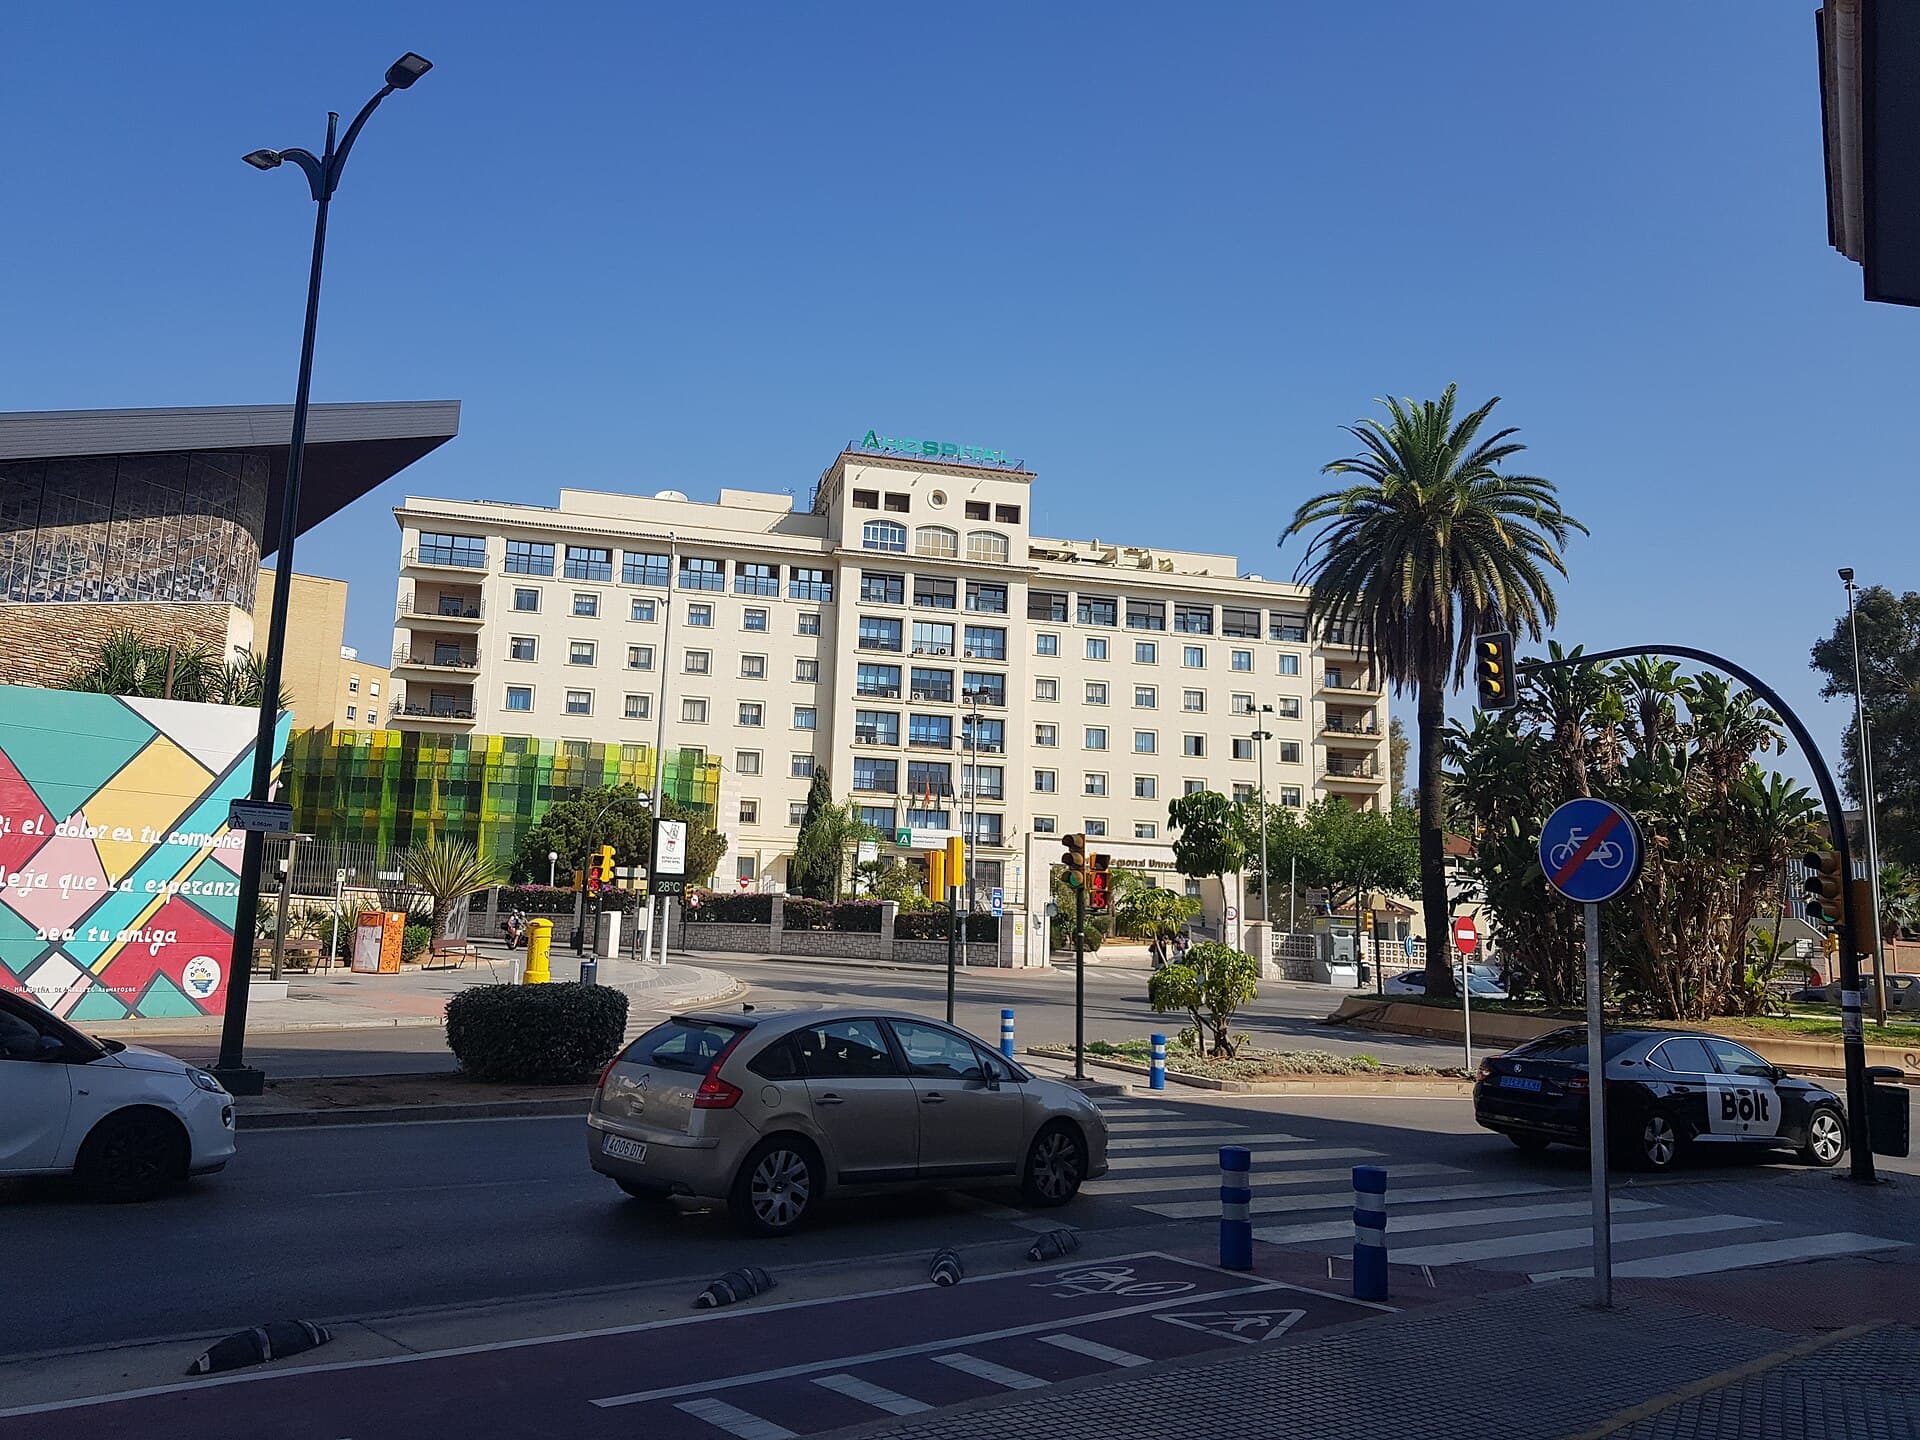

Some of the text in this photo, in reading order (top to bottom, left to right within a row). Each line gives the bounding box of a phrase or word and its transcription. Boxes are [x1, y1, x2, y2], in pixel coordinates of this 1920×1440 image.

[882, 436, 1015, 464] HOSPITAL
[22, 814, 44, 835] el
[55, 815, 108, 839] dolor
[112, 827, 133, 841] es
[141, 825, 161, 844] tu
[168, 831, 244, 853] compañe
[1148, 859, 1175, 869] Unive
[59, 874, 97, 899] que
[658, 881, 680, 892] 28°C
[36, 925, 177, 956] sea tu amiga
[1719, 1087, 1770, 1131] Bolt
